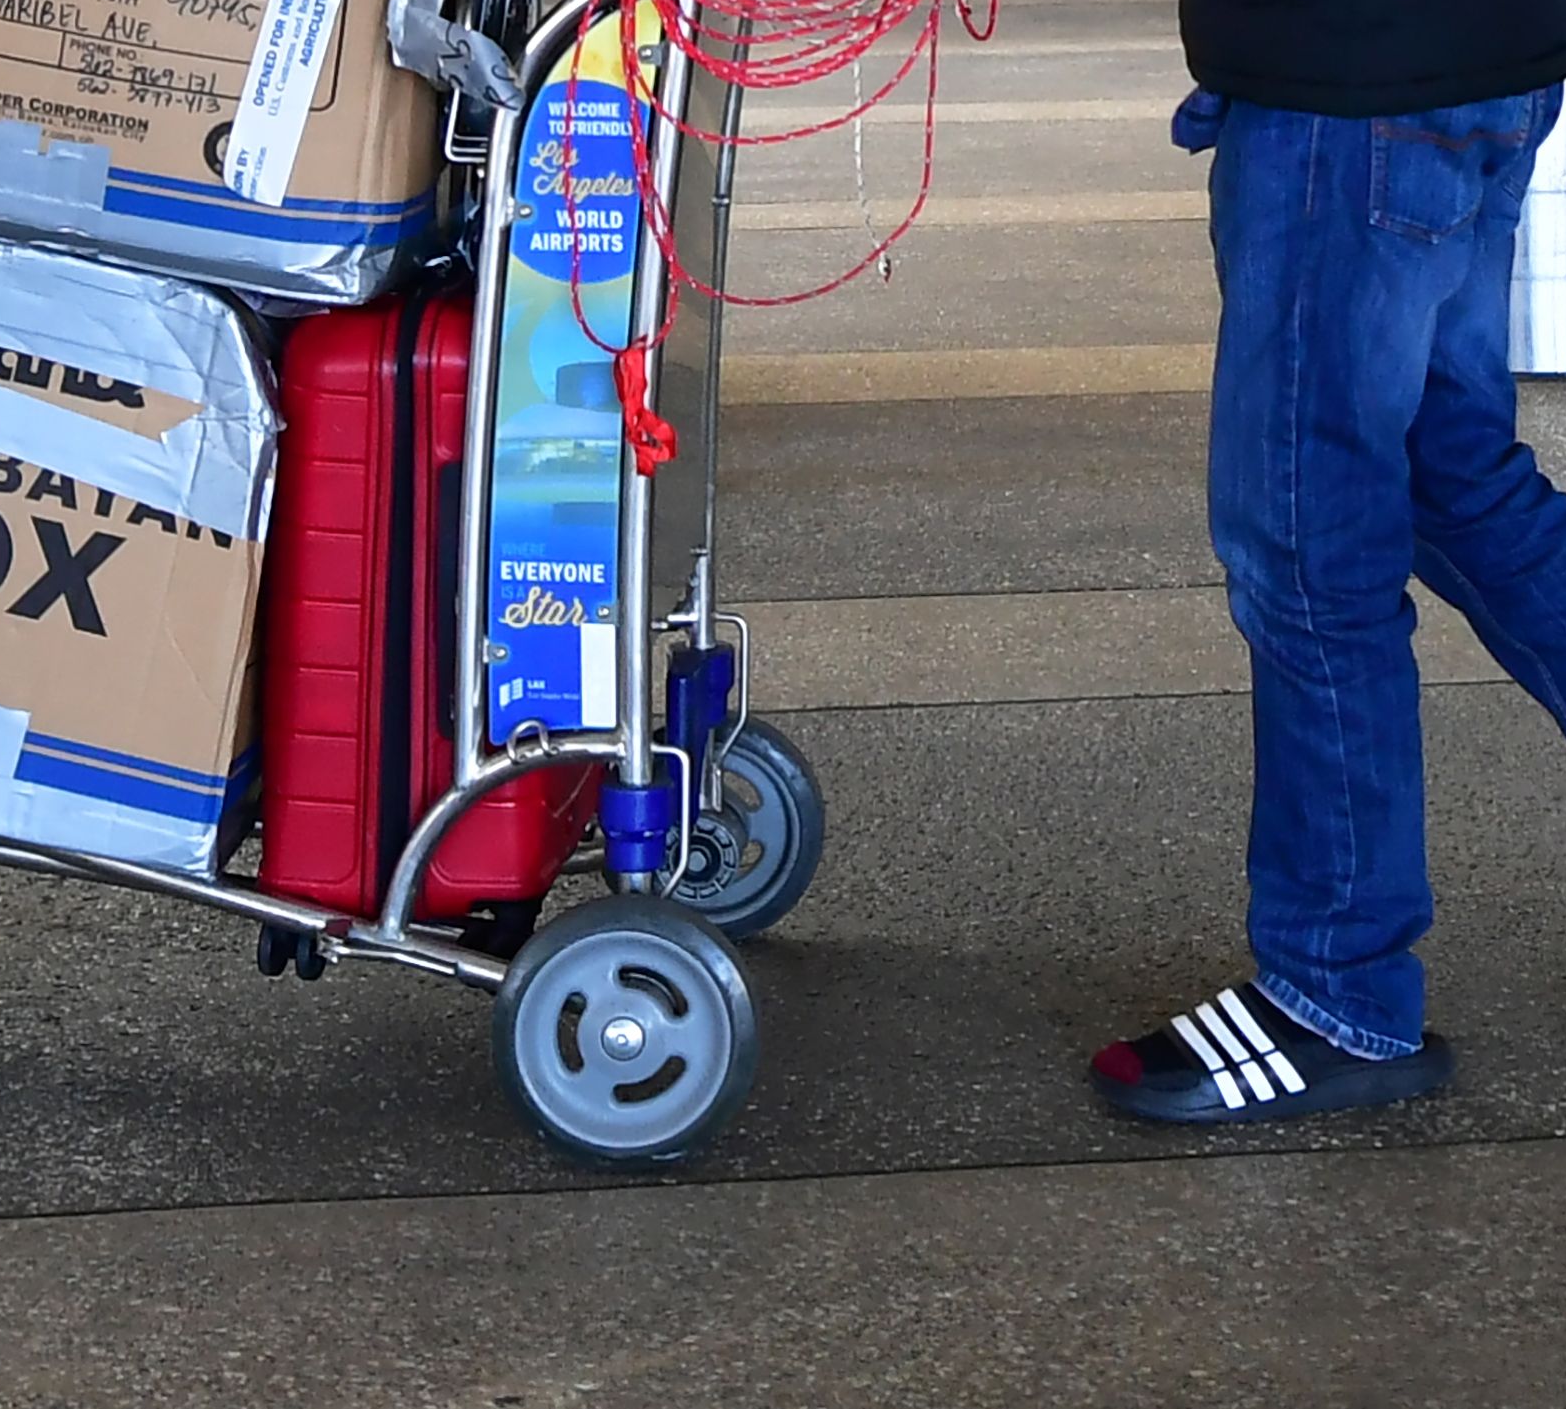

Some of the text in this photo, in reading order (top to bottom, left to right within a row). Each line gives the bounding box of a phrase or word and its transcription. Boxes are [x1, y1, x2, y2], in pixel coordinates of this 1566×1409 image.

[69, 37, 112, 58] PHONE
[253, 50, 278, 108] OPENED
[269, 18, 288, 49] FOR
[29, 96, 150, 133] CORPORATION
[547, 101, 621, 118] WLCOME
[548, 119, 566, 136] TO
[237, 147, 251, 169] BY
[533, 170, 635, 205] Angeles
[555, 208, 624, 230] WORLD
[529, 232, 625, 253] AIRPORTS
[499, 559, 606, 584] EVERYONE
[500, 585, 526, 600] IS A
[498, 585, 589, 629] Star
